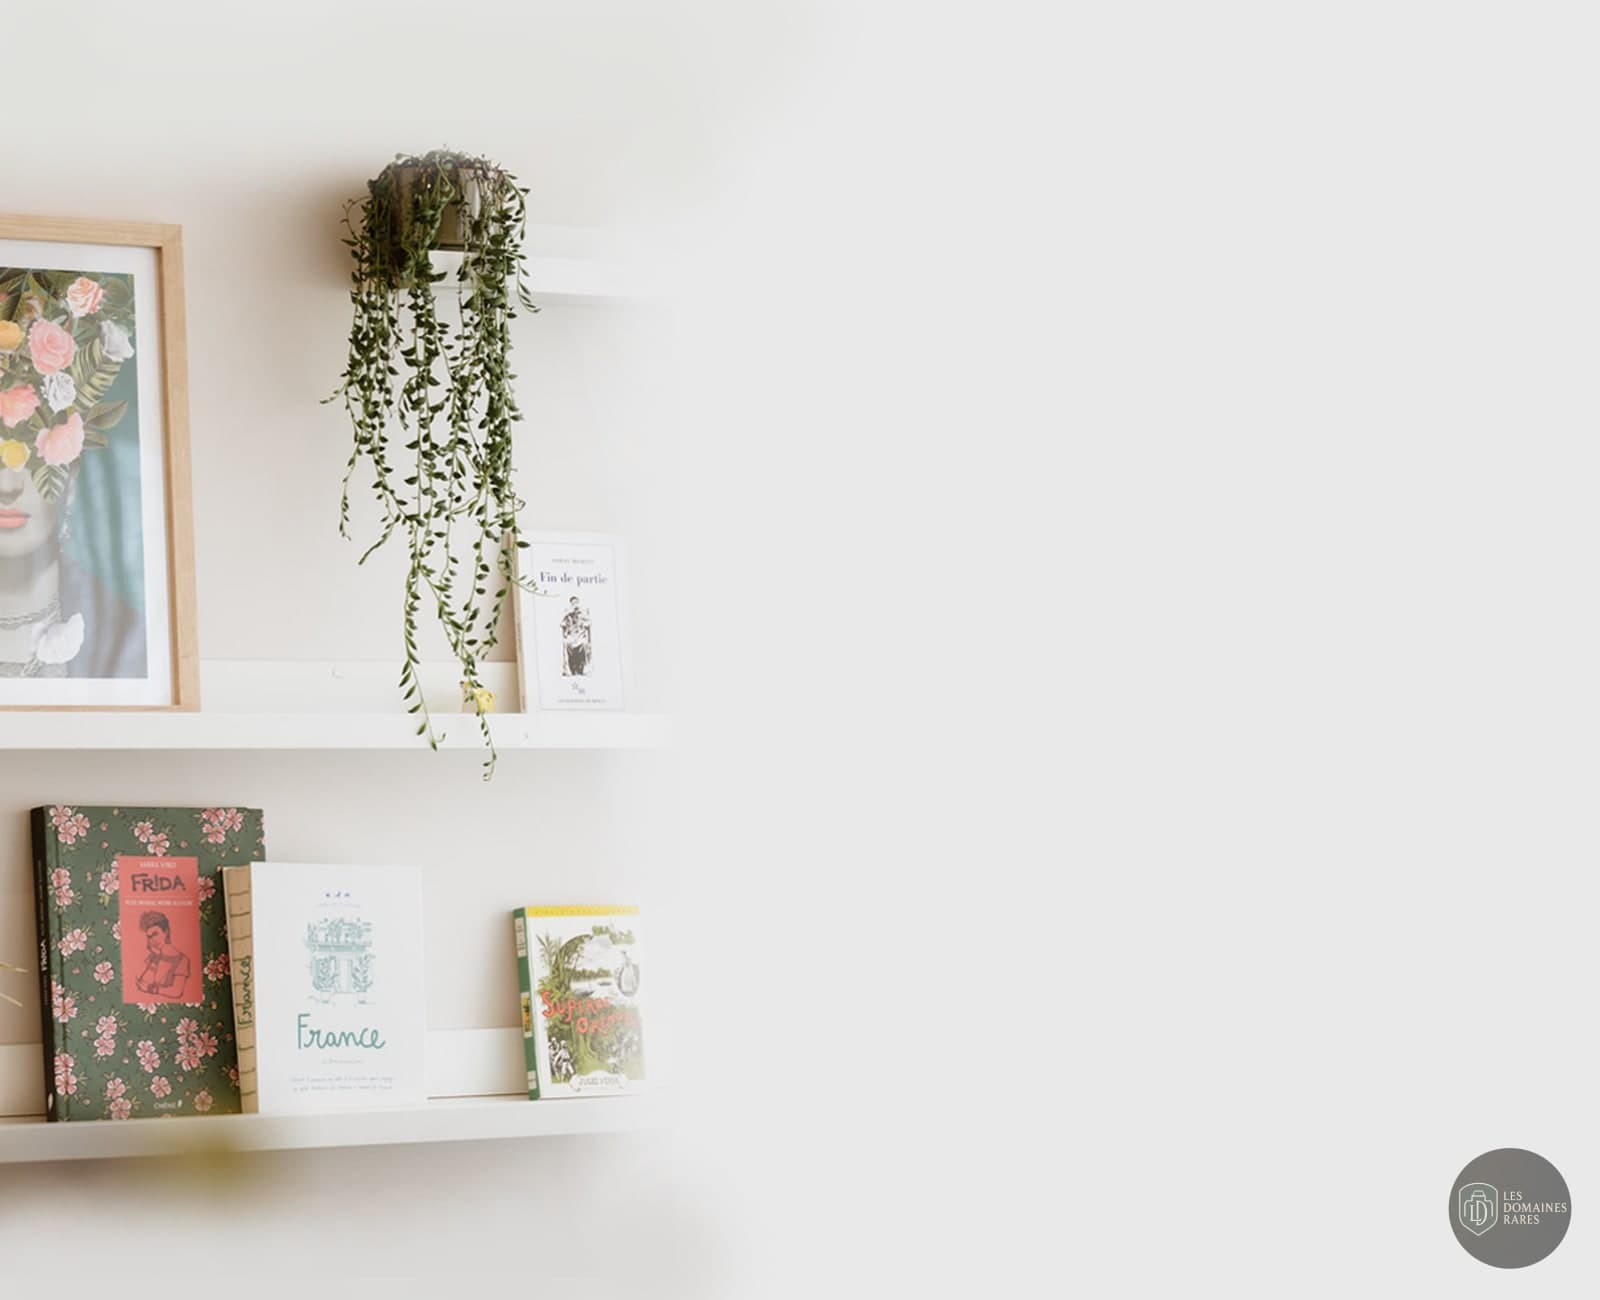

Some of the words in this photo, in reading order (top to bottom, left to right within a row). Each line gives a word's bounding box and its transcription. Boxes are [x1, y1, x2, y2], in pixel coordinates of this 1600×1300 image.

[540, 571, 557, 582] Fin
[560, 572, 574, 583] de
[576, 572, 608, 587] partie
[131, 872, 187, 893] FRIDA
[237, 955, 252, 1026] France
[298, 1013, 386, 1050] France
